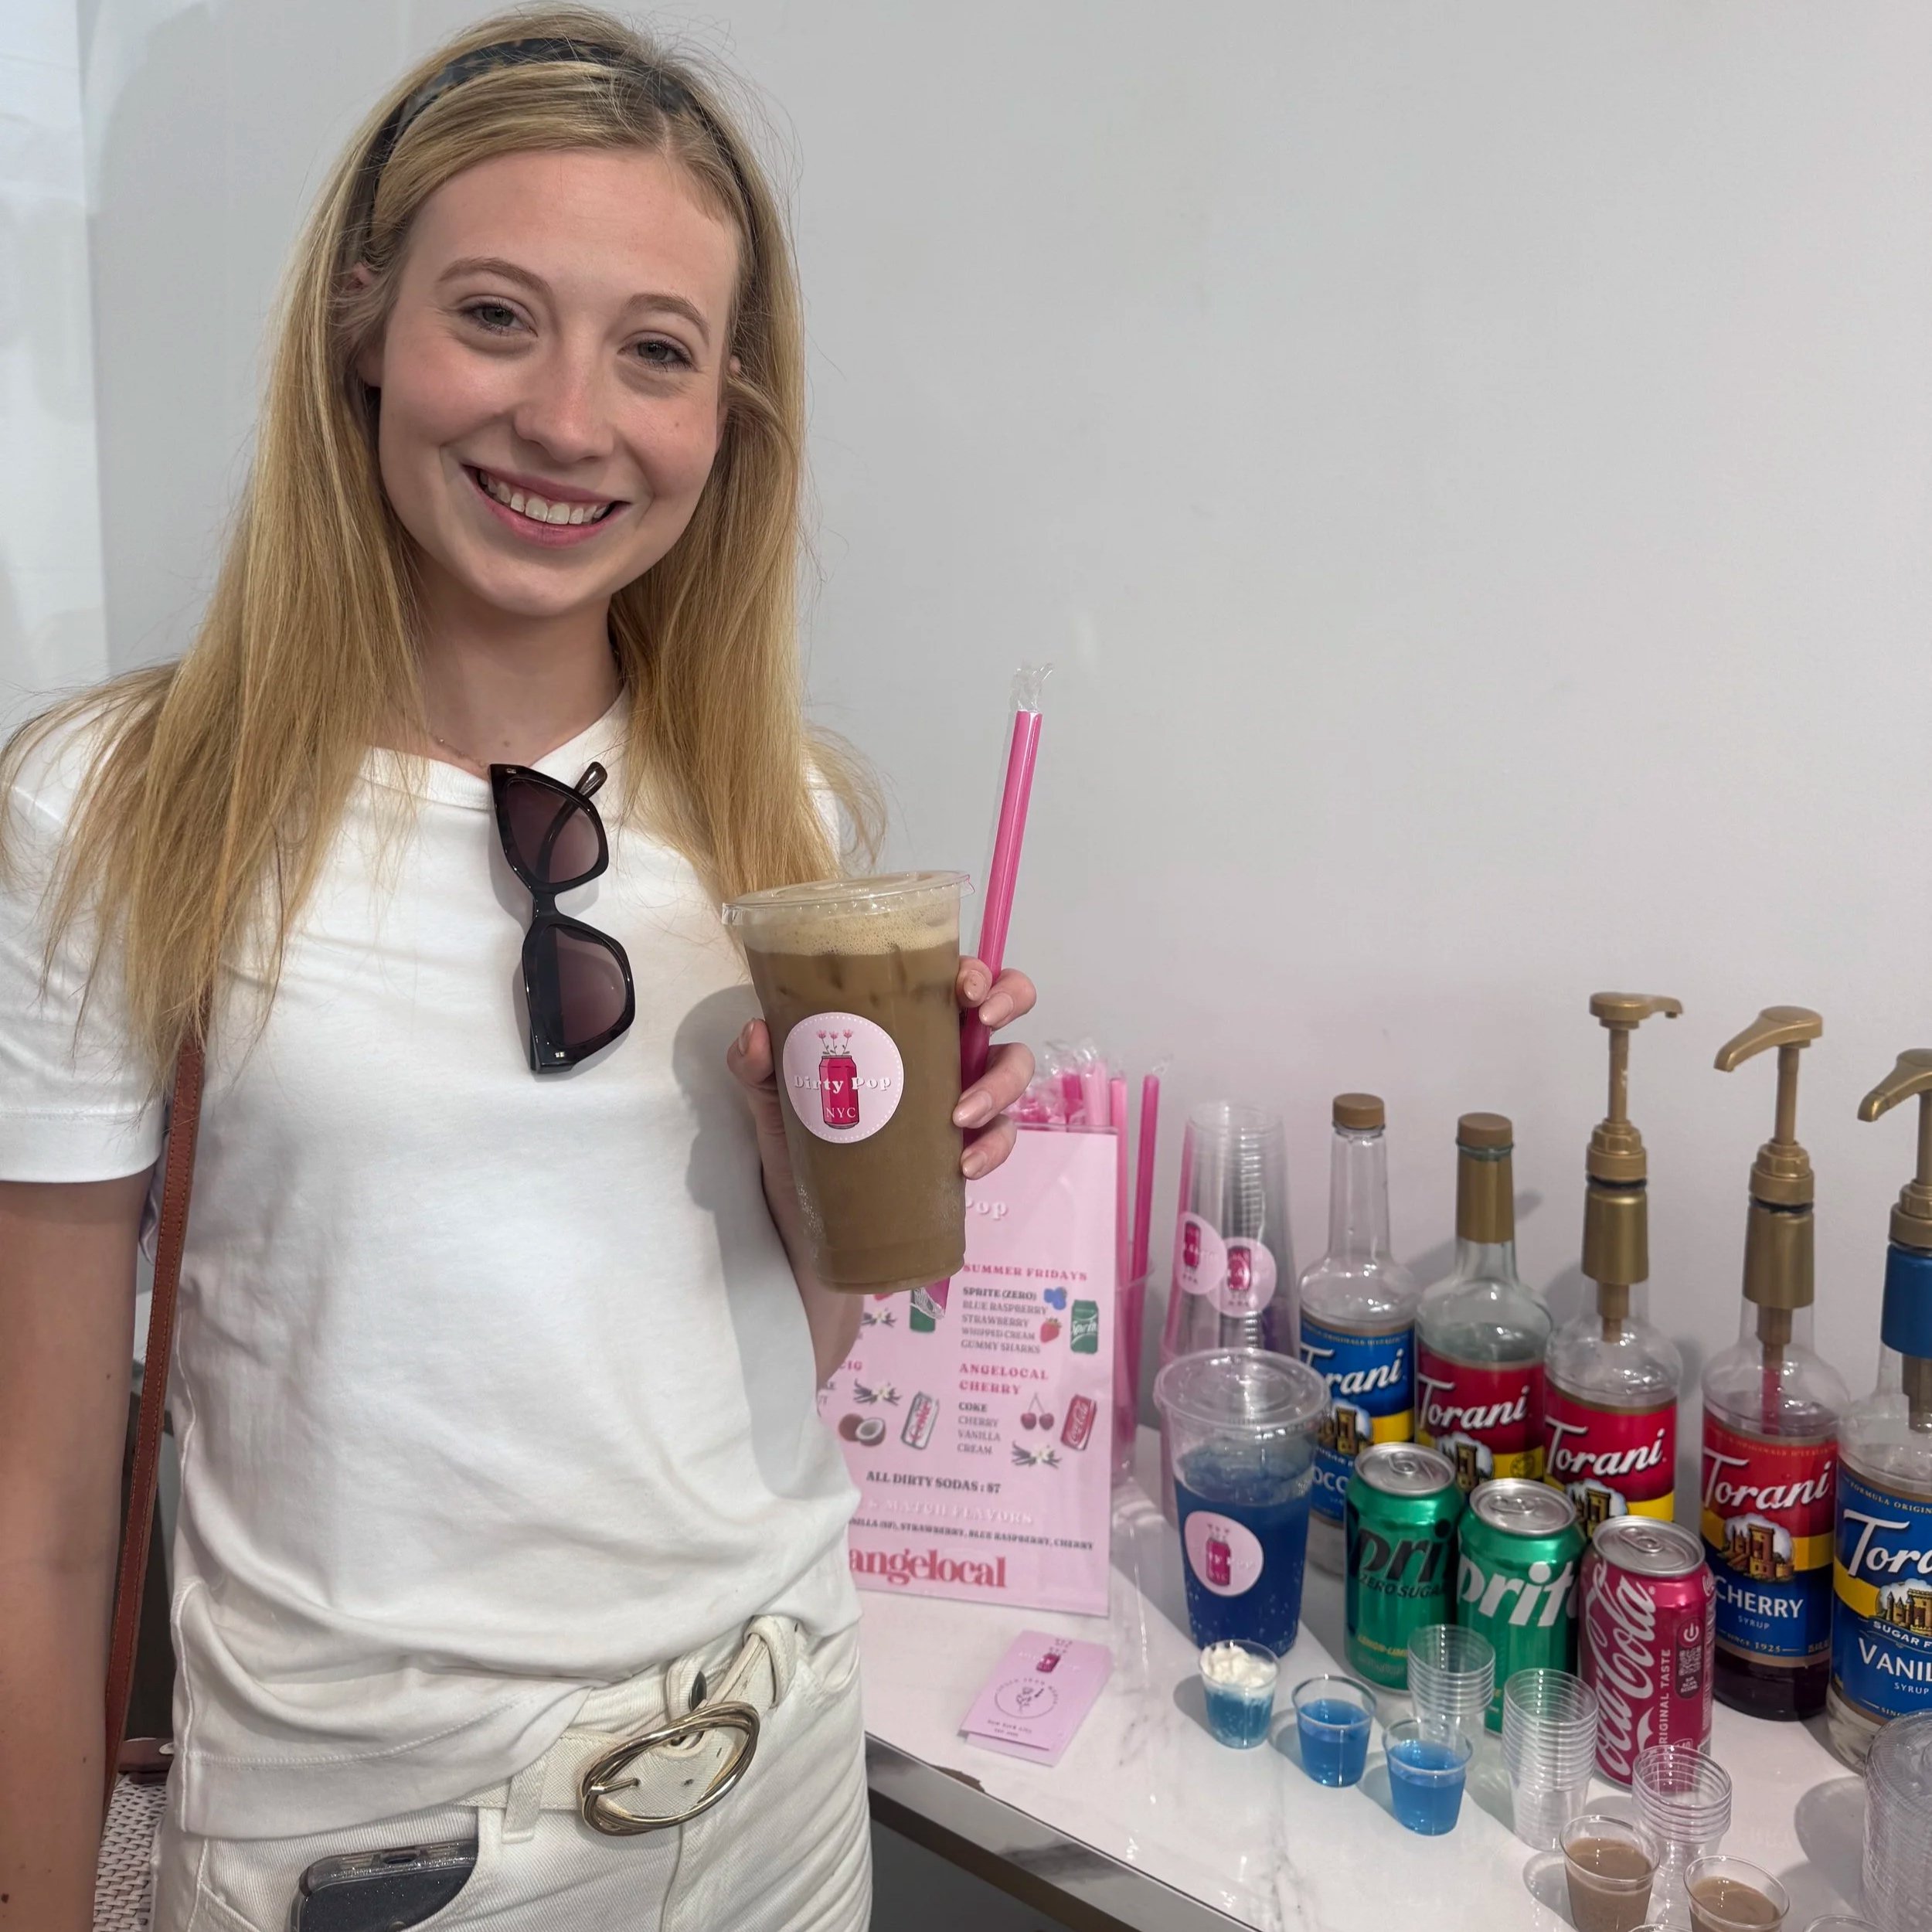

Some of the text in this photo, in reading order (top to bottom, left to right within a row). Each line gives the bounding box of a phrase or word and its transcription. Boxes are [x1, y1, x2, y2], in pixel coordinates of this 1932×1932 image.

[794, 1075, 891, 1094] Dirty Pop
[826, 1107, 856, 1118] NYC
[963, 1264, 1087, 1281] SUMMER FRIDAYS
[962, 1287, 1036, 1301] SPRITE (ZERO)
[962, 1300, 1047, 1315] BLUE RASPBERRY
[961, 1314, 1029, 1327] STRAWBERRY
[1005, 1329, 1036, 1340] CREAM
[961, 1339, 1040, 1354] GUMMY SHARKS
[959, 1363, 1049, 1379] ANGELOCAL
[1299, 1341, 1404, 1395] Trani
[959, 1380, 1020, 1395] CHERRY
[958, 1402, 987, 1413] COKE
[1417, 1372, 1530, 1430] Torani
[958, 1416, 998, 1428] CHERRY
[958, 1429, 1001, 1441] VANILLA
[957, 1443, 992, 1455] CREAM
[1546, 1414, 1665, 1476] Torani
[866, 1471, 890, 1483] ALL
[893, 1473, 933, 1488] DIRTY
[935, 1476, 978, 1492] SODAS
[1702, 1446, 1832, 1510] Torani
[1850, 1481, 1932, 1515] FORMULA ORIGIN
[952, 1505, 1033, 1525] FLAVORS
[1053, 1538, 1093, 1551] CHERRY
[849, 1548, 1007, 1588] angelocal
[1359, 1573, 1396, 1595] ZERO
[1714, 1576, 1804, 1619] CHERRY
[1738, 1615, 1770, 1630] SYRUP
[1872, 1621, 1920, 1646] SUGAR
[1755, 1641, 1781, 1653] 1925
[1859, 1637, 1932, 1682] VANIL
[1658, 1648, 1672, 1744] RIGINAL TASTE
[1894, 1682, 1930, 1695] SYRUP
